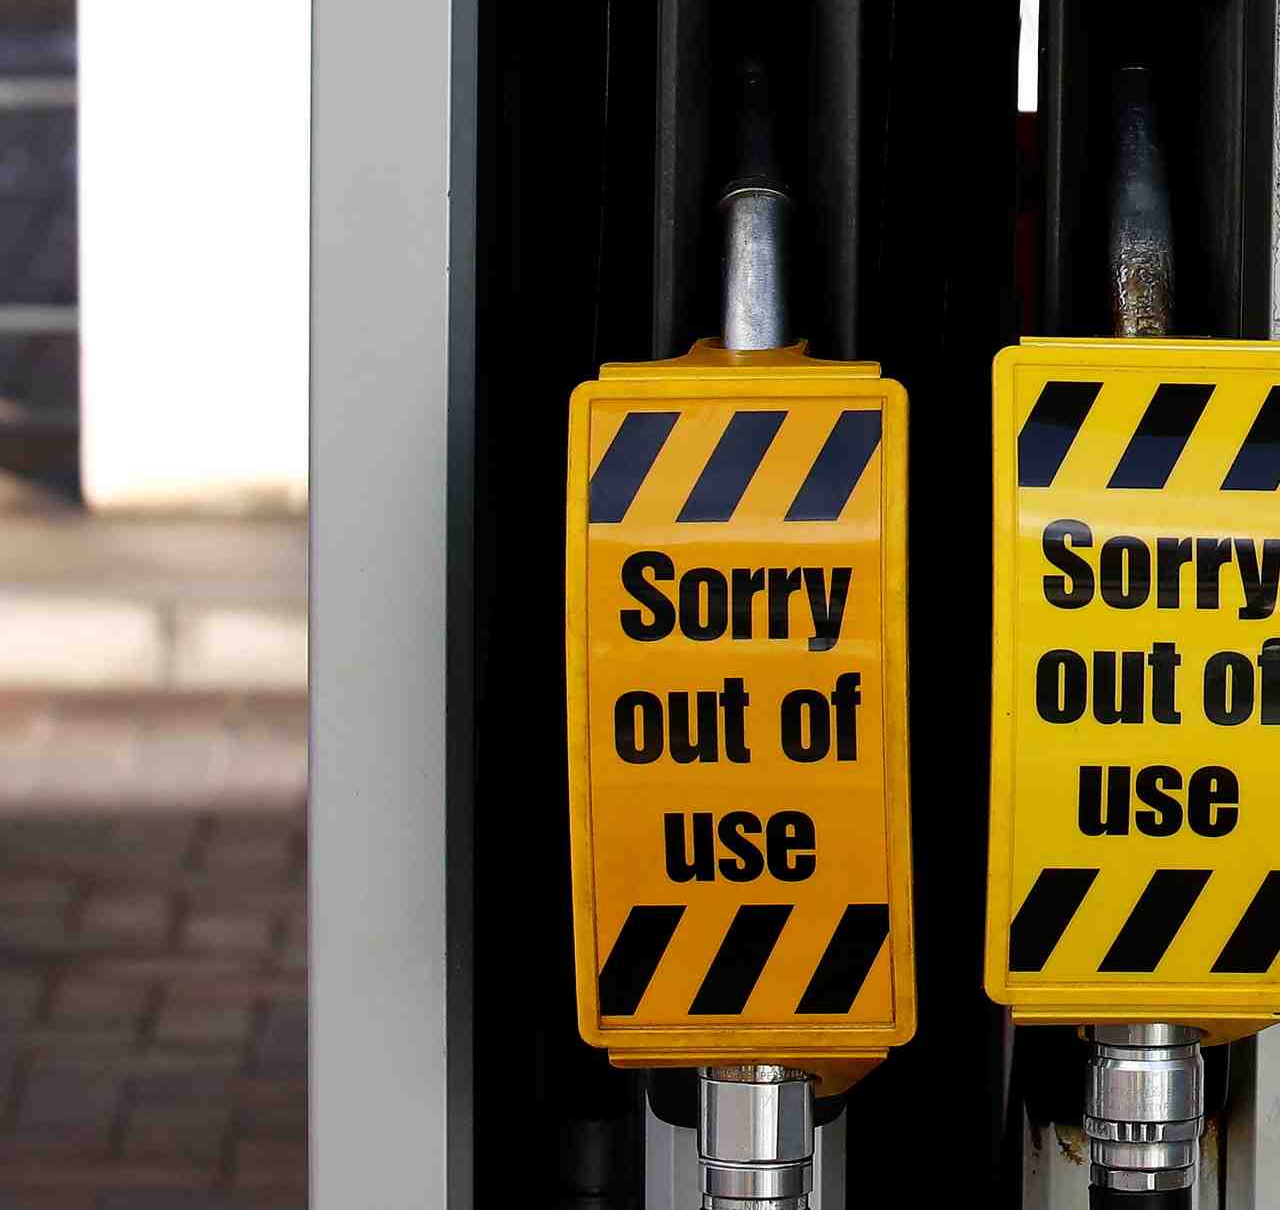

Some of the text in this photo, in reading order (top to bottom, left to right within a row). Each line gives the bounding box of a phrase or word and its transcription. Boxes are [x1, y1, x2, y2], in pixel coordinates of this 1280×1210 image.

[619, 550, 852, 652] Sorry
[614, 672, 861, 764] out of
[1035, 641, 1181, 724] out
[1077, 764, 1240, 838] use
[663, 809, 817, 882] use
